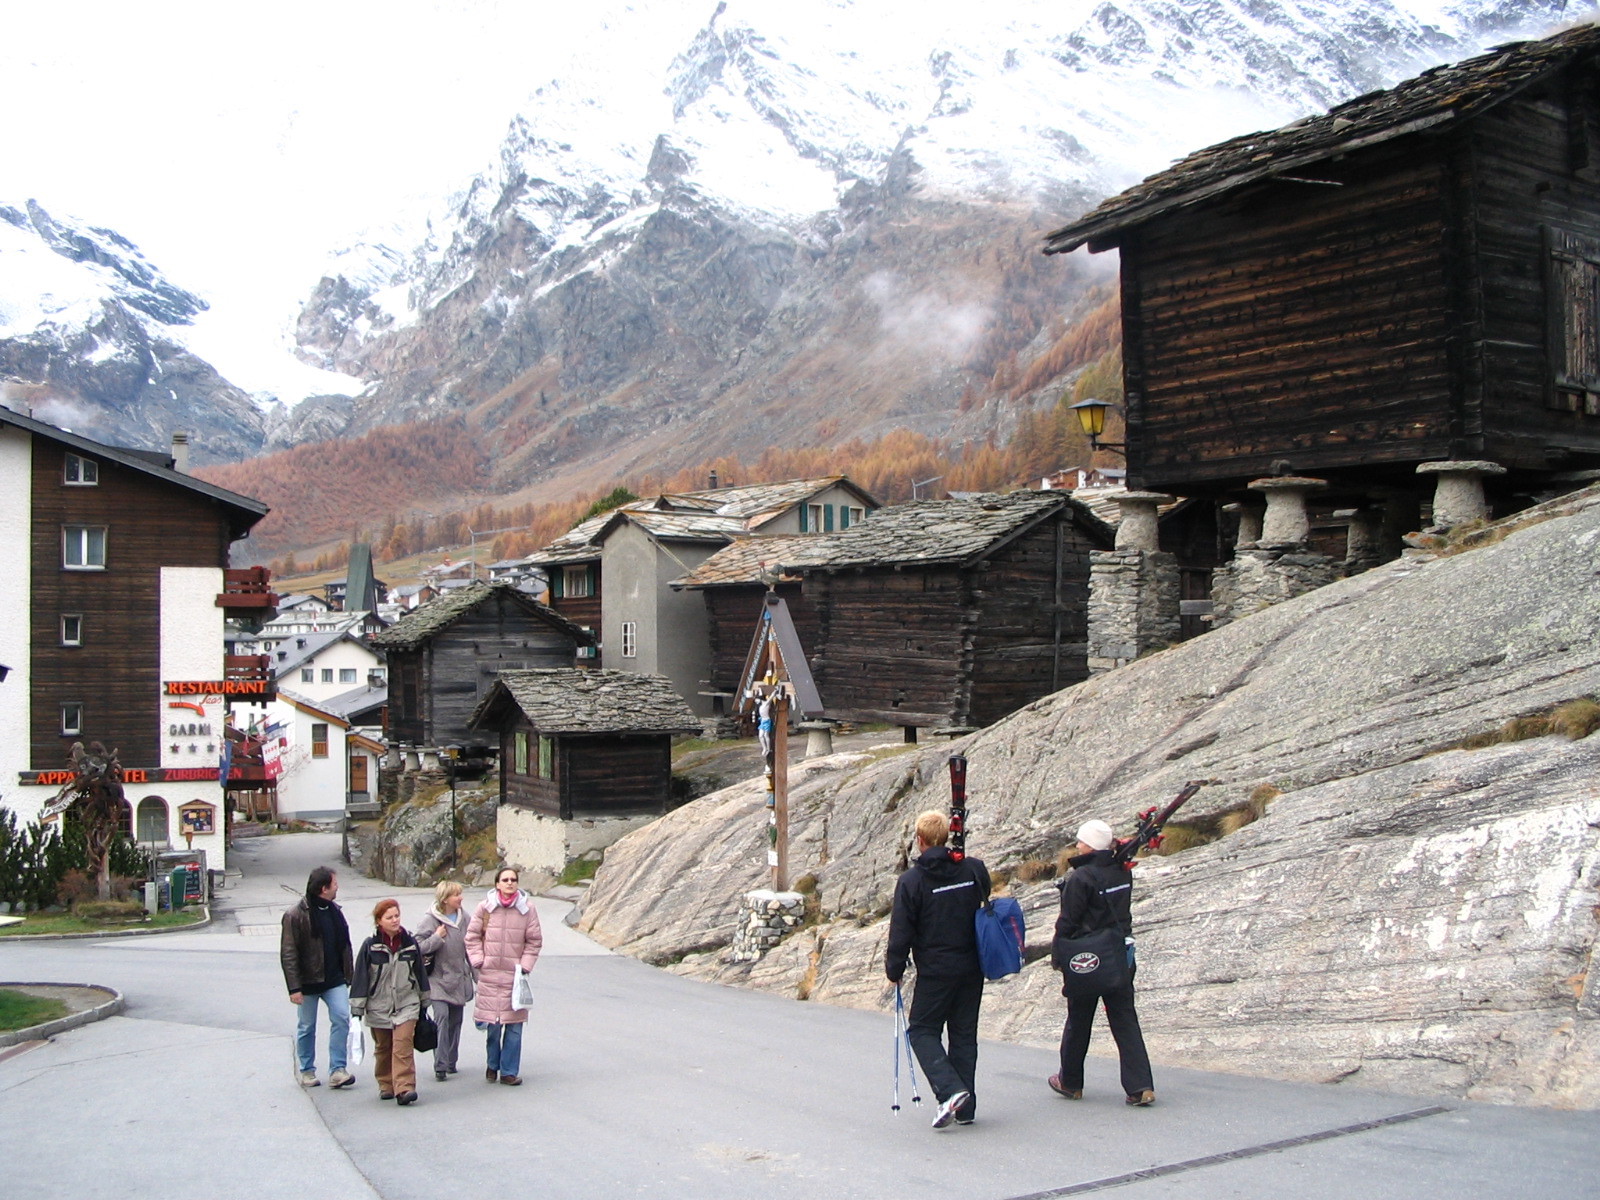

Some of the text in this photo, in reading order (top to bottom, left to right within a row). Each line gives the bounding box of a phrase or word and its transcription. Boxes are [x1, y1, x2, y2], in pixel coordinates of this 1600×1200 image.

[168, 681, 267, 694] RESTAURANT
[169, 723, 211, 736] GARNI
[36, 768, 243, 784] APPATEL ZURBRIGEN
